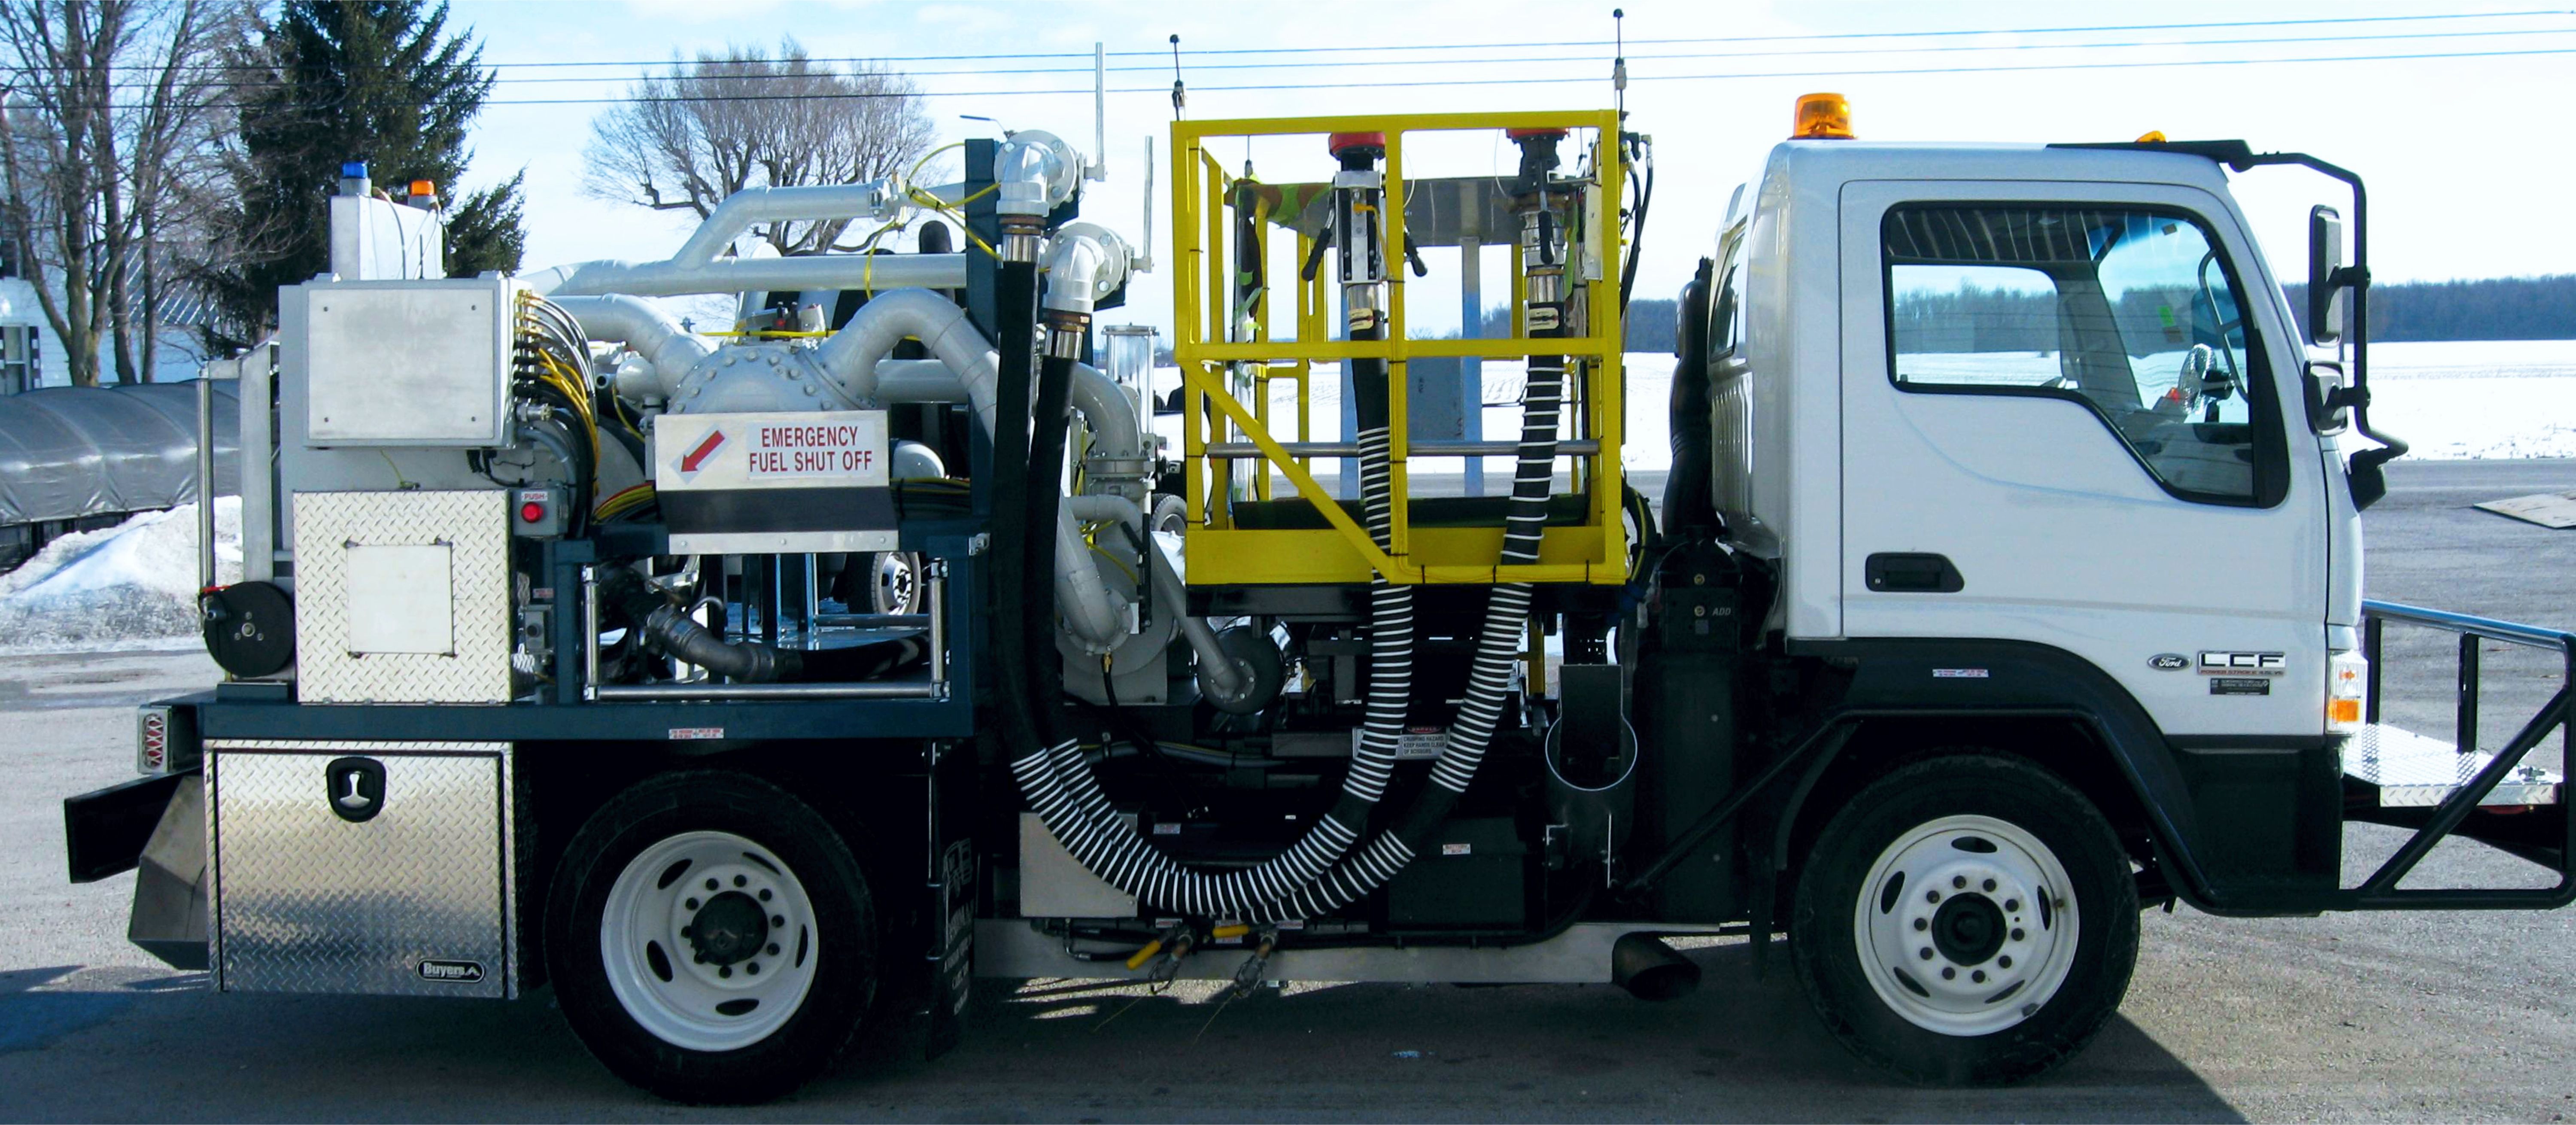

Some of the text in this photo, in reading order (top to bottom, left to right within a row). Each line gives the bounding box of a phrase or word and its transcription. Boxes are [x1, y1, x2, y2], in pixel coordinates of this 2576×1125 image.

[761, 426, 858, 447] EMERGENCY
[750, 450, 872, 472] FUEL SHUT OFF
[1712, 608, 1731, 616] ADD
[2159, 657, 2182, 667] Ford
[2201, 654, 2284, 667] LCF
[423, 962, 465, 977] Buyers
